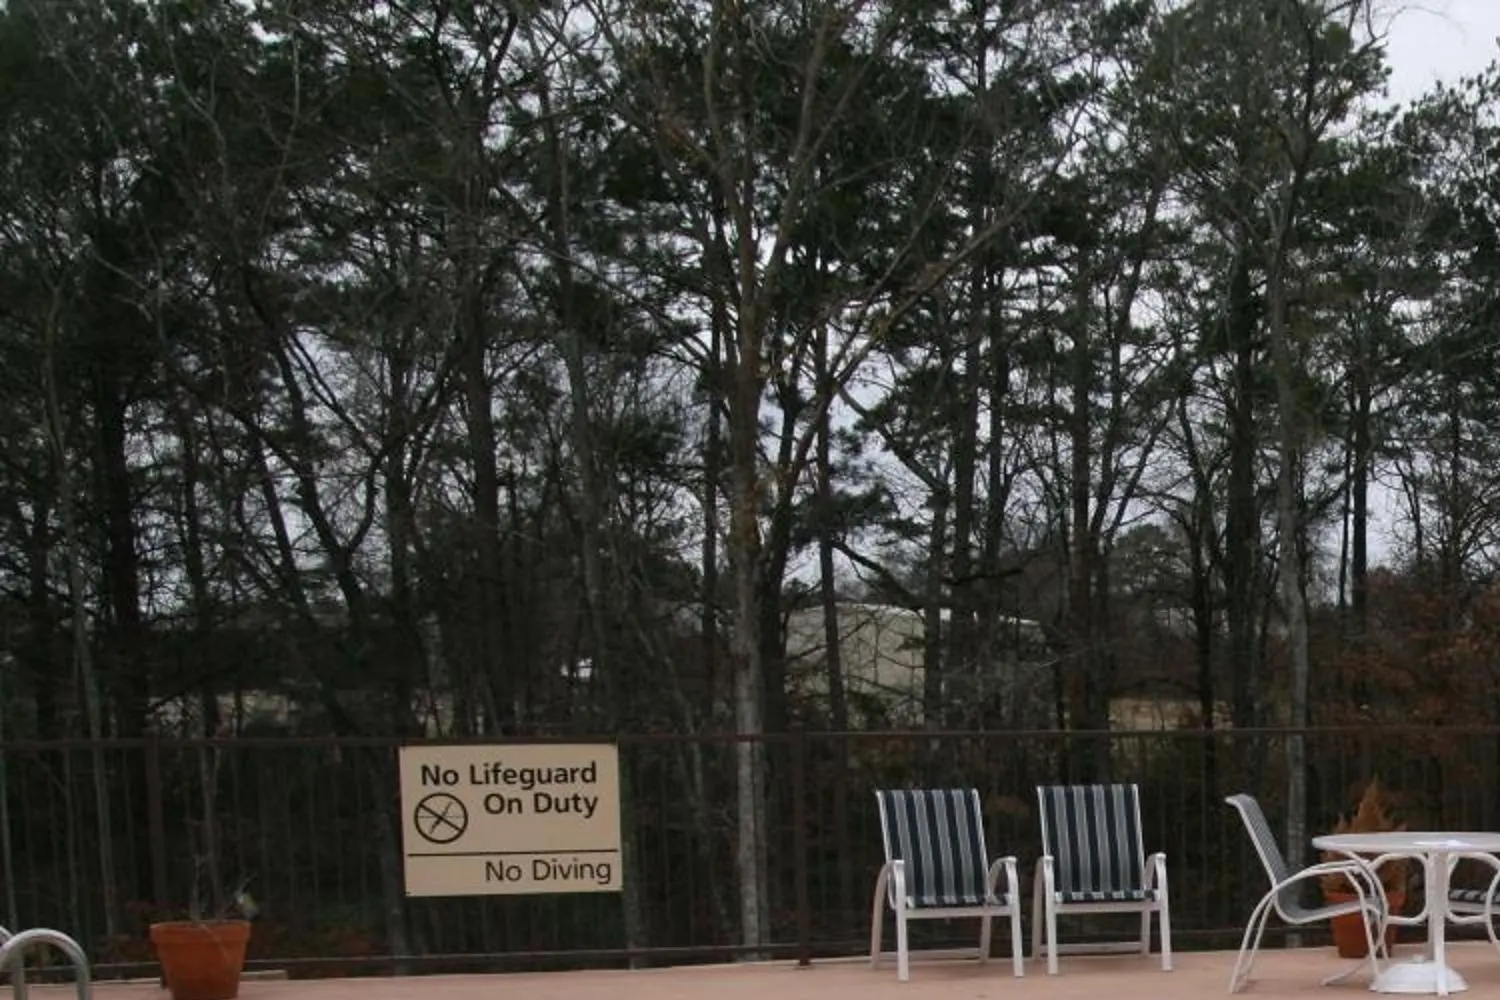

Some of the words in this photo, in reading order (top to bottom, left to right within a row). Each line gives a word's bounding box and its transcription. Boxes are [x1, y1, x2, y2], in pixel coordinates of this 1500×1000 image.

[420, 764, 459, 786] No
[470, 761, 598, 790] Lifeguard
[483, 792, 523, 815] On
[534, 792, 599, 819] Duty
[485, 860, 522, 882] No
[532, 858, 612, 885] Diving
